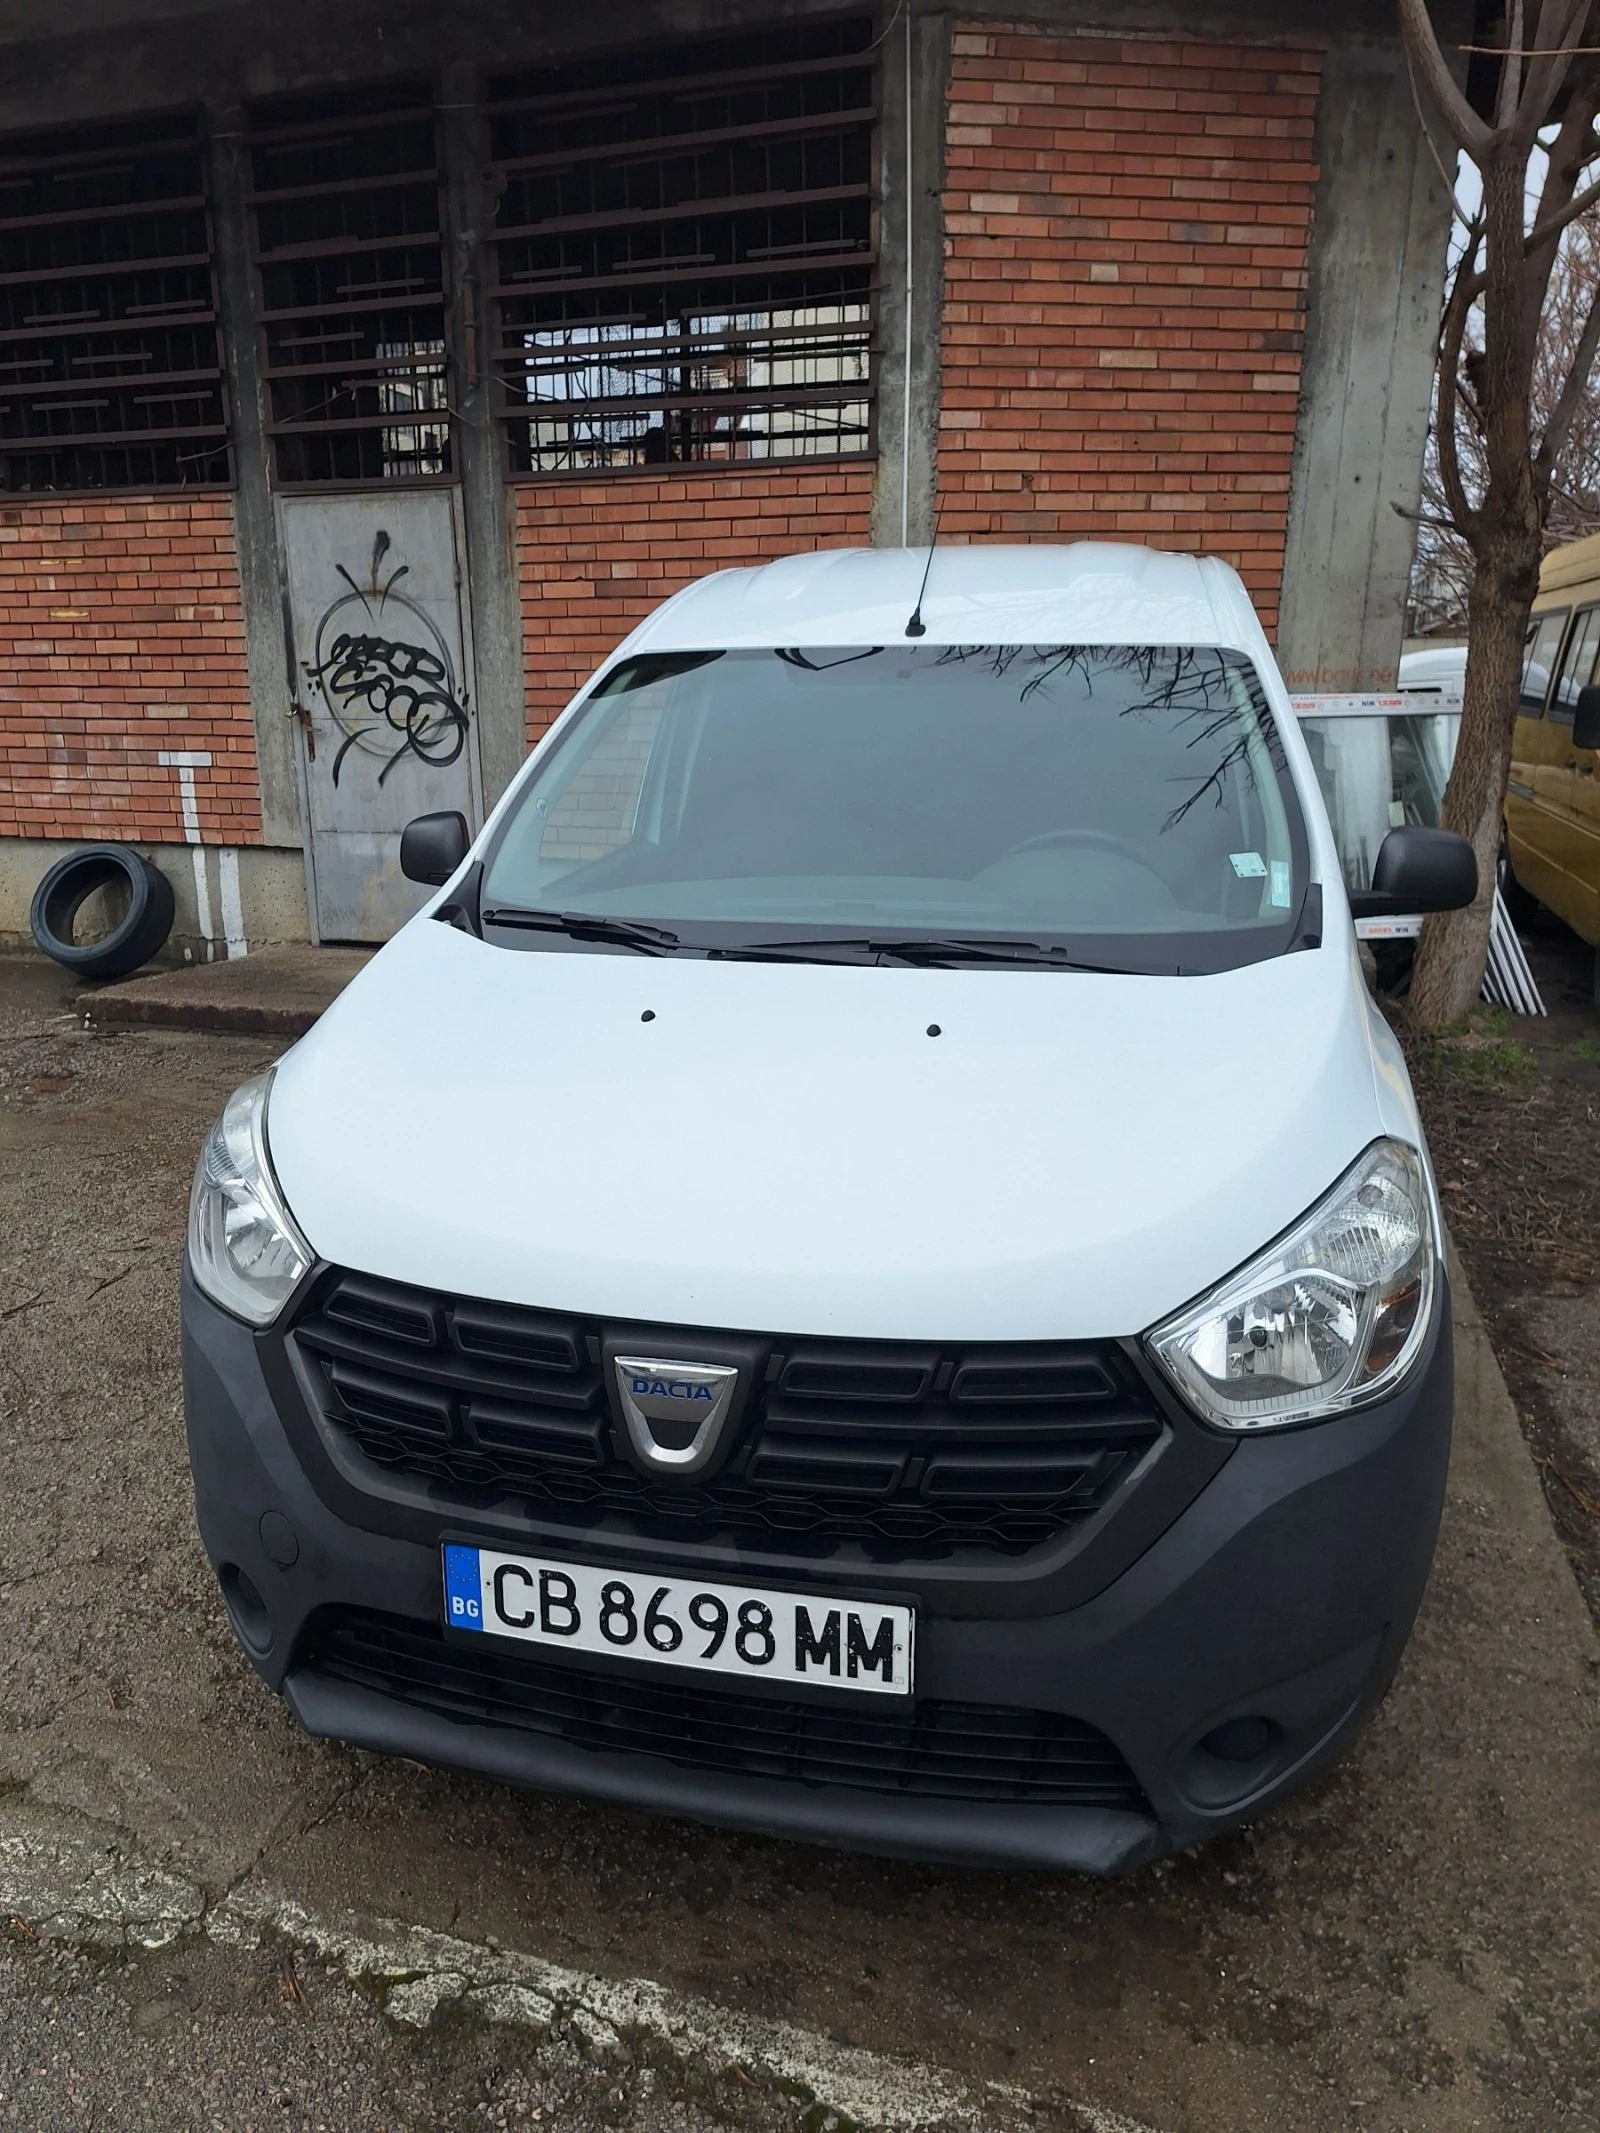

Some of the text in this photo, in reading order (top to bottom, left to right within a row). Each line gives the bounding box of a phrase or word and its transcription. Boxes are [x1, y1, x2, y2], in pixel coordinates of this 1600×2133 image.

[632, 1379, 713, 1402] DACIA
[451, 1596, 480, 1618] BG
[493, 1563, 894, 1683] CB 8698 MM
